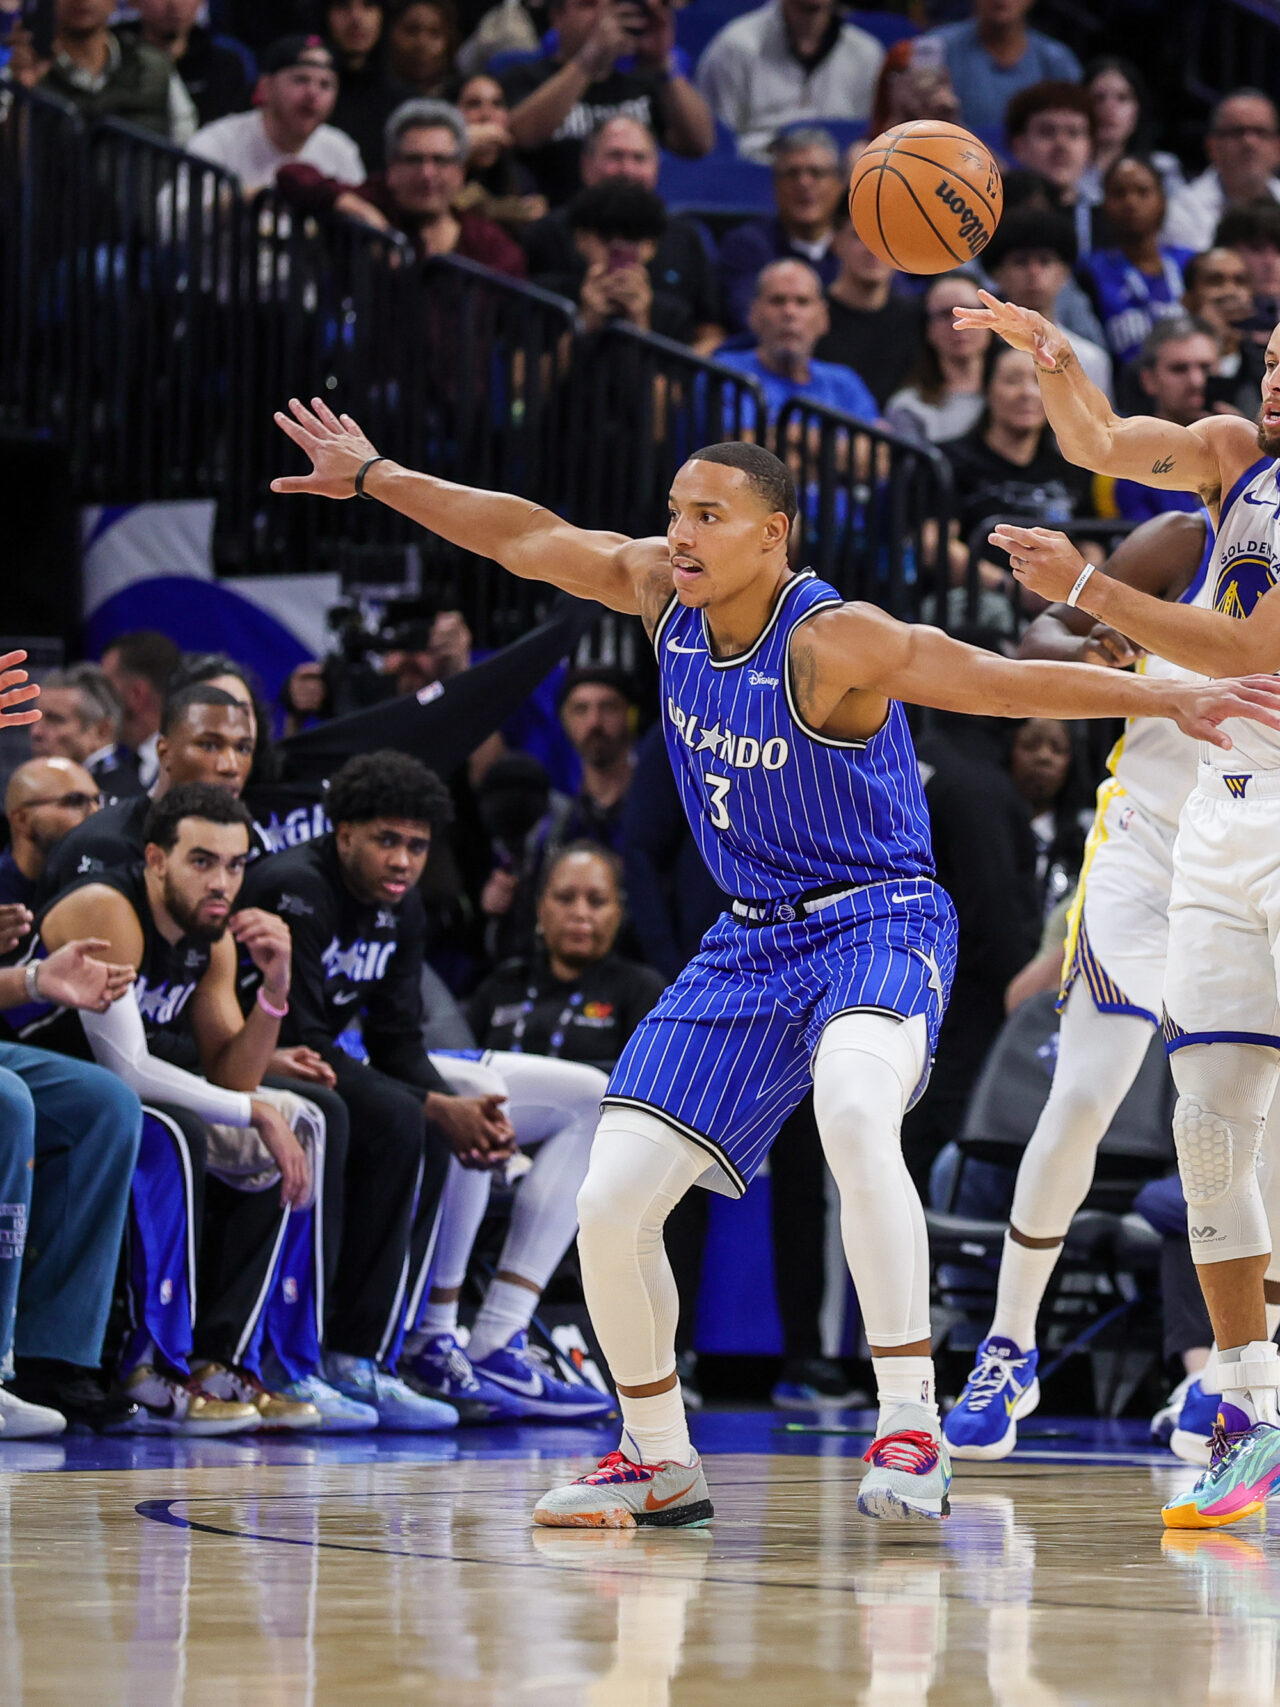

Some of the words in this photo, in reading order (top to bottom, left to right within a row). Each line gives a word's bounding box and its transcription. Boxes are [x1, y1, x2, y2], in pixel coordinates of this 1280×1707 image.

[935, 179, 990, 257] Wilson
[1220, 540, 1272, 565] GOLDEN
[704, 772, 732, 832] 3
